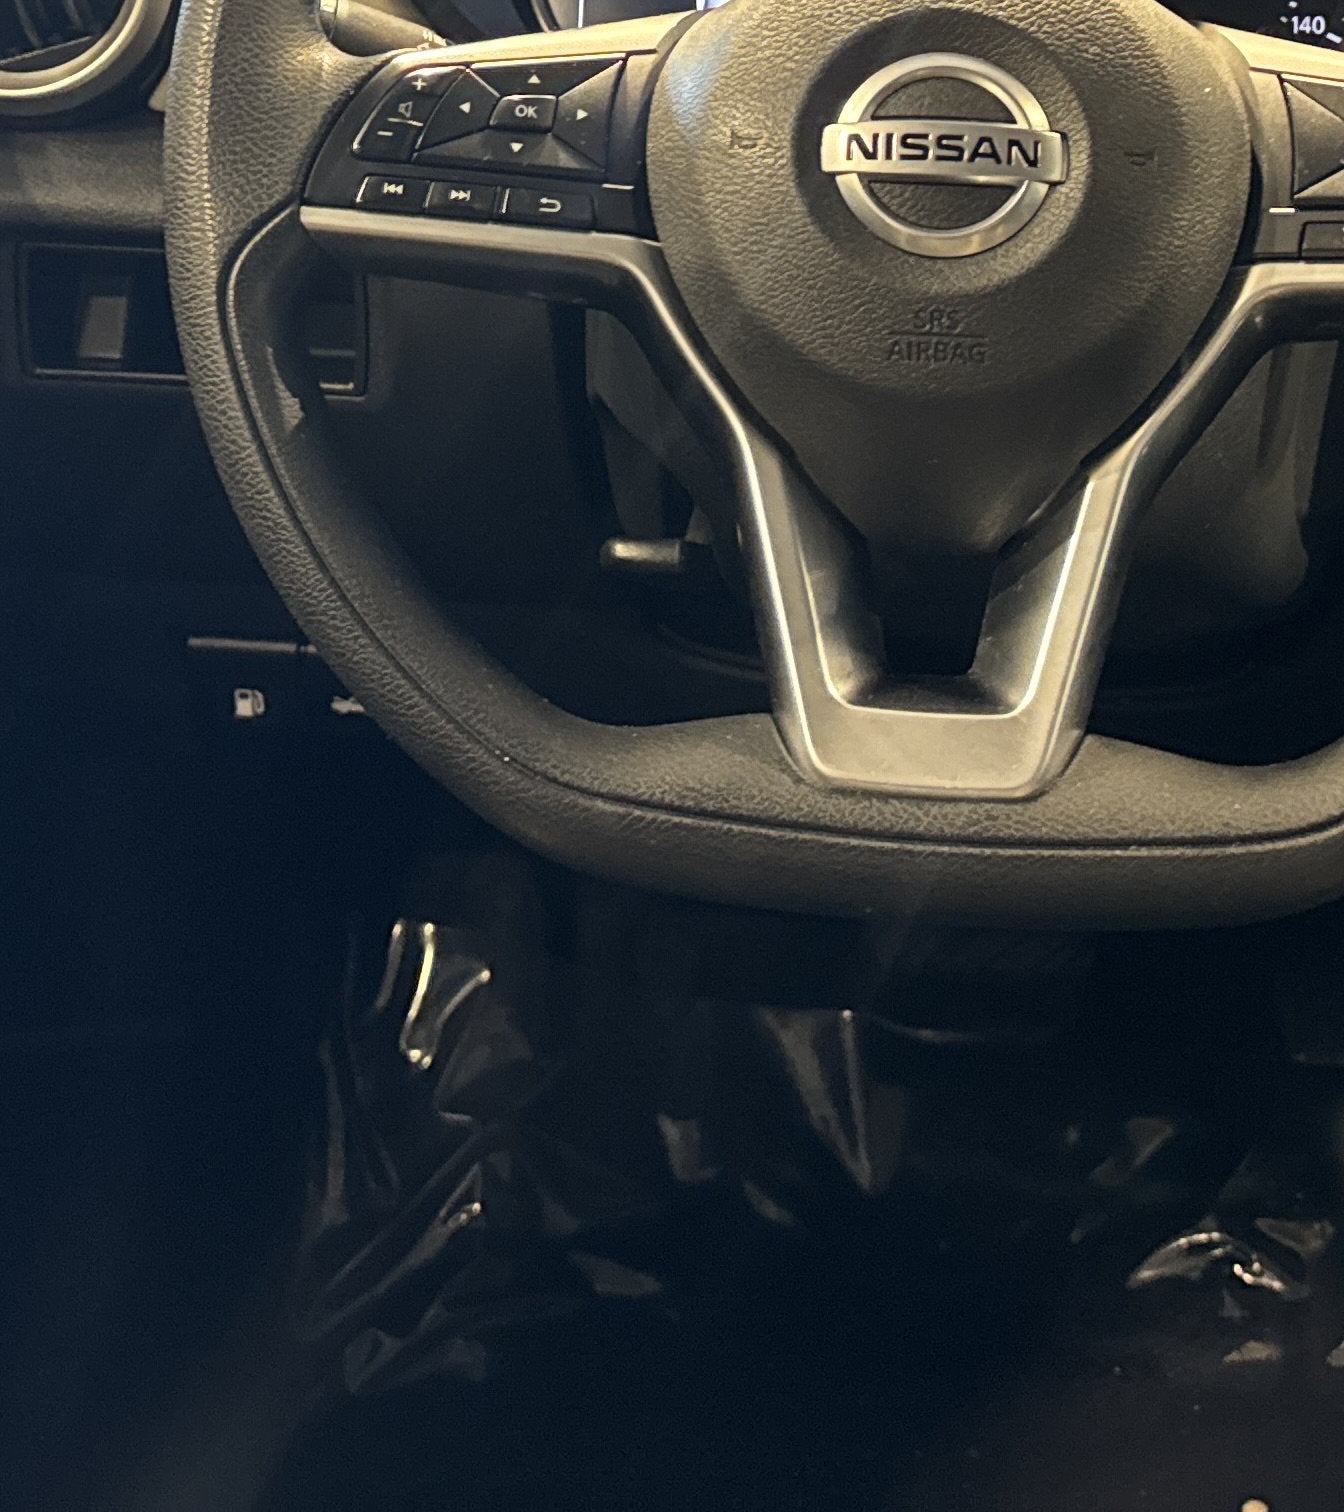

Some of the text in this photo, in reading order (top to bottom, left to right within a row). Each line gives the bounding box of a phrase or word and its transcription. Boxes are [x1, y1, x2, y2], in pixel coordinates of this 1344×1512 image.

[1291, 16, 1326, 34] 140
[515, 104, 538, 119] OK
[845, 132, 1042, 168] NISSAN
[886, 339, 988, 364] AIRBAG
